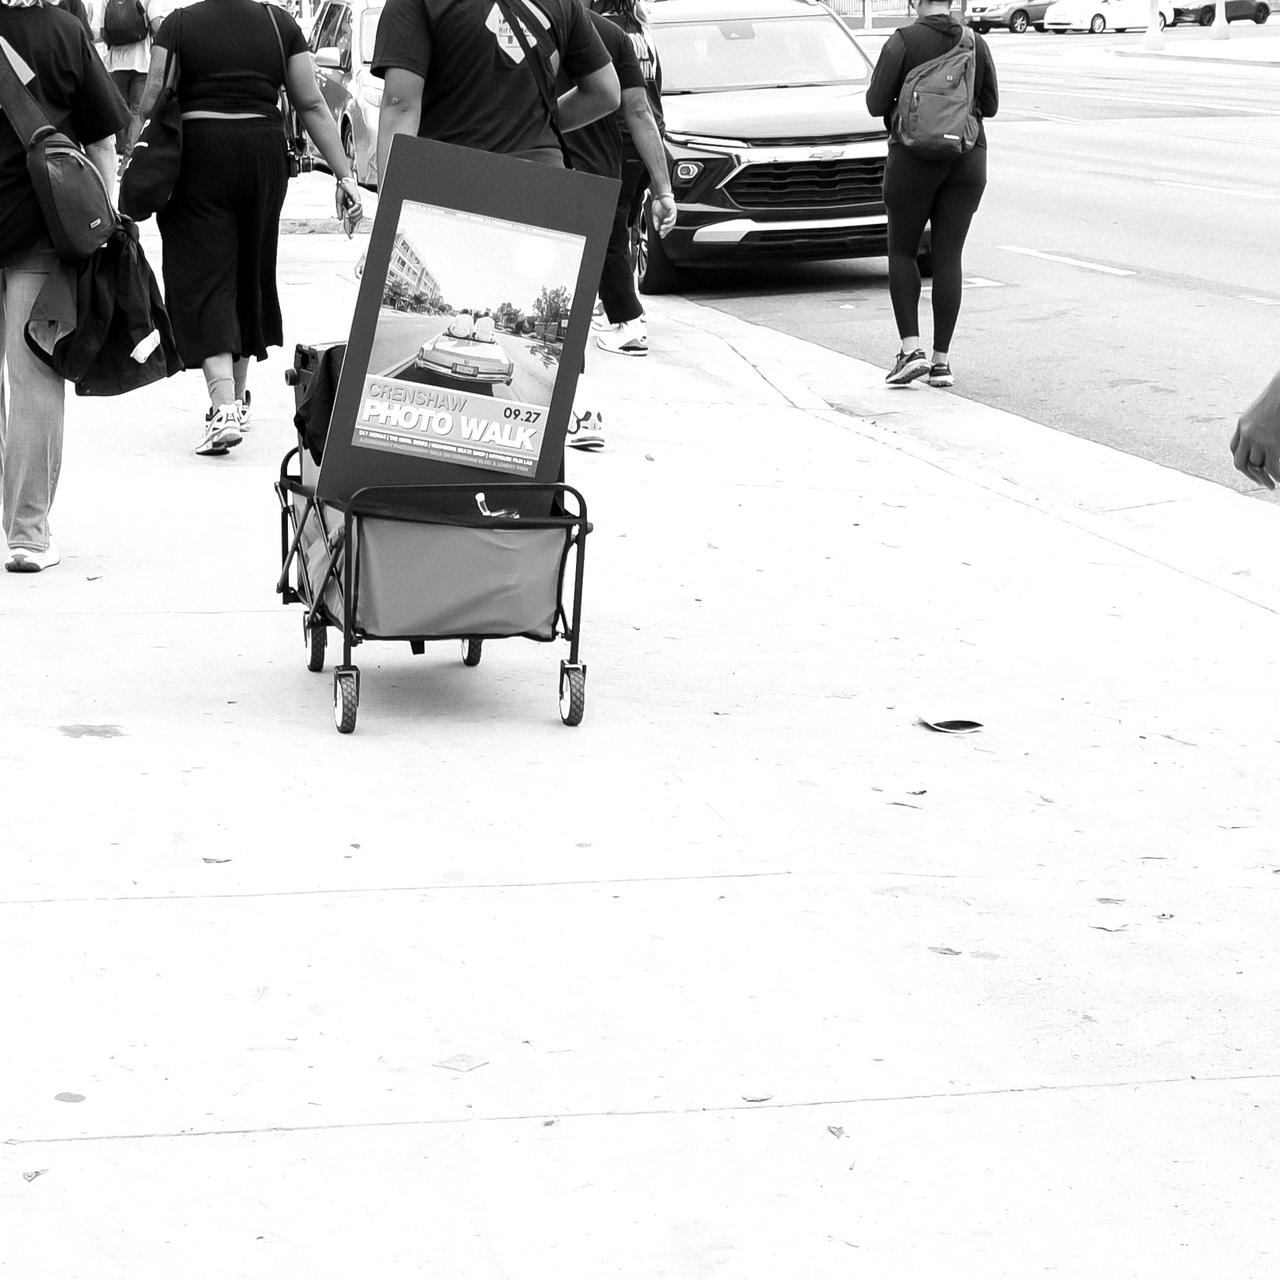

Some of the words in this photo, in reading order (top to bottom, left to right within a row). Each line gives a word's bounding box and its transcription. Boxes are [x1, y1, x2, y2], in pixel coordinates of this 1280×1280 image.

[369, 383, 468, 413] CRENSHAW
[362, 398, 454, 437] PHOTO
[461, 415, 538, 452] WALK
[503, 406, 542, 424] 09.27
